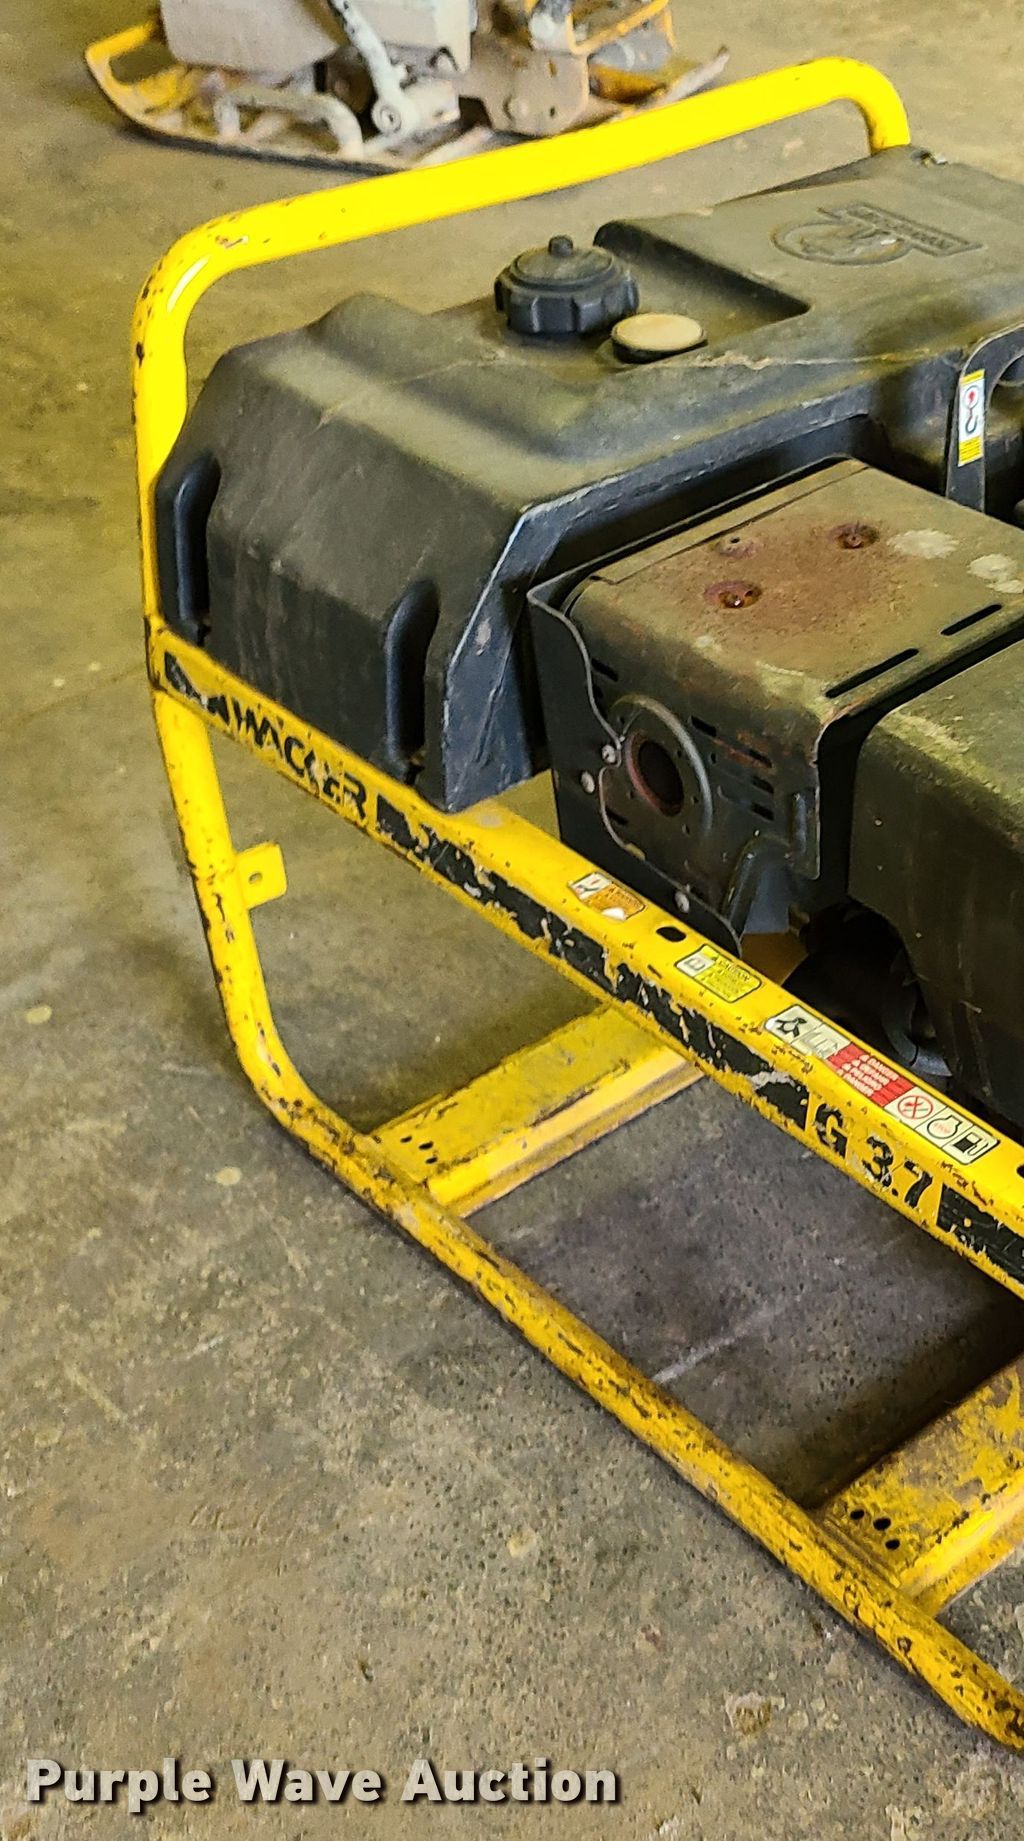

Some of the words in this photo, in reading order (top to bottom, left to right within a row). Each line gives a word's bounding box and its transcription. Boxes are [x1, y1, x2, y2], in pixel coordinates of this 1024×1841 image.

[866, 1057, 899, 1081] DANGER
[815, 1103, 848, 1159] G
[861, 1135, 934, 1208] 3.7
